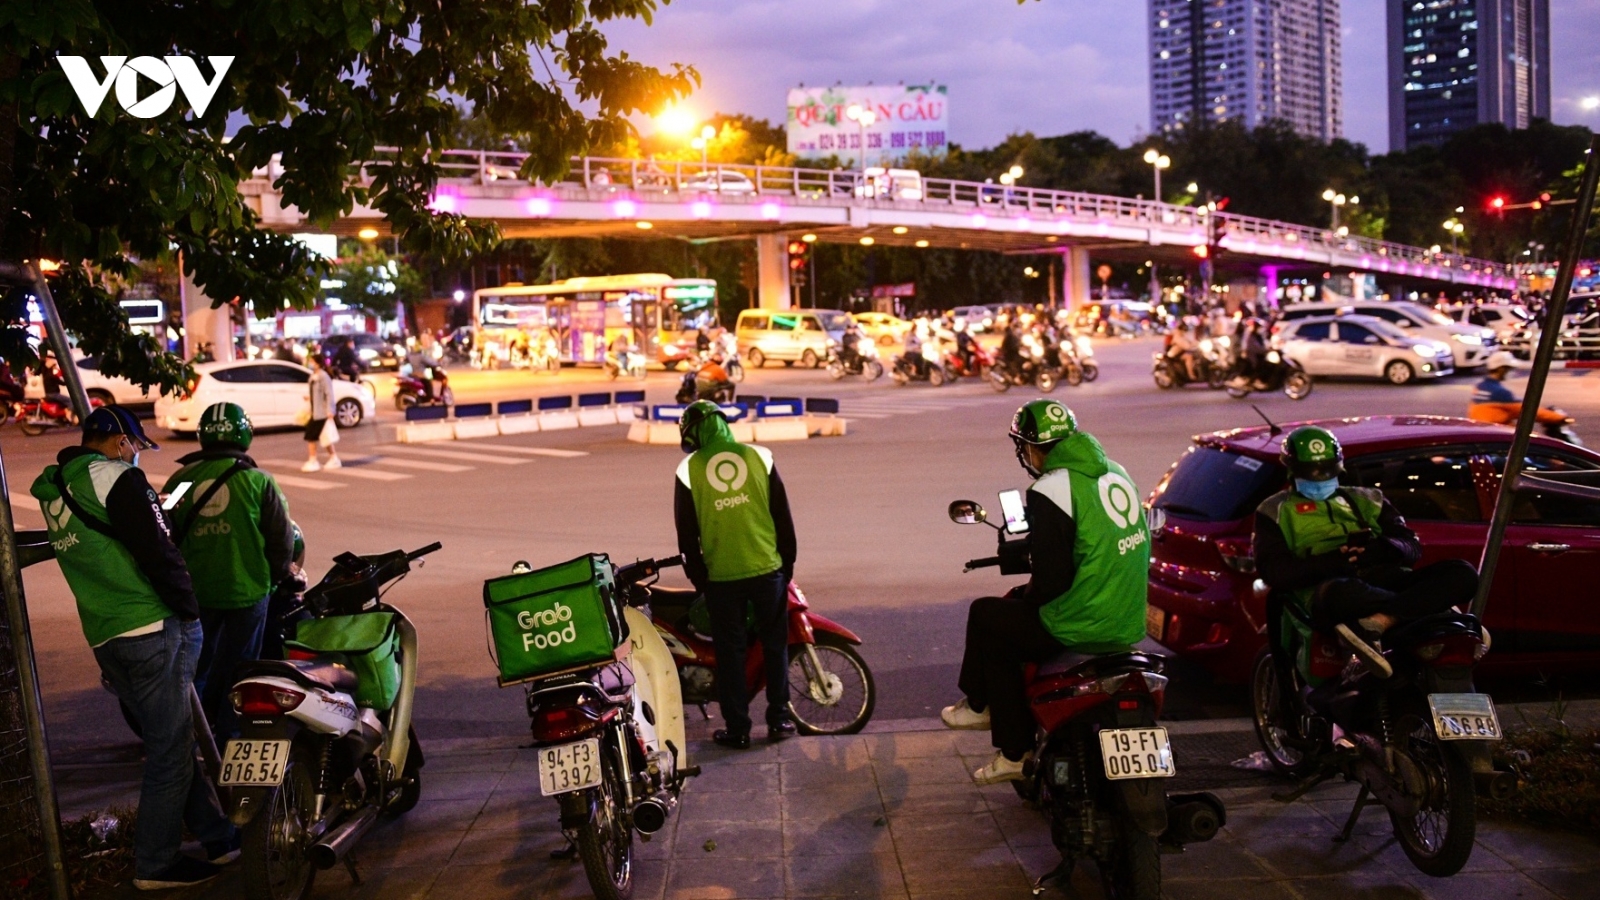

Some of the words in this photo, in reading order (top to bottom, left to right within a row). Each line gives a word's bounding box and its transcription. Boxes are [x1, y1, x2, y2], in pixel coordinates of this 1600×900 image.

[832, 98, 893, 122] TN
[205, 420, 234, 433] Grab
[1050, 423, 1069, 432] gojek
[714, 493, 750, 511] gojek
[193, 518, 232, 537] Grab
[1117, 528, 1146, 555] gojek
[517, 602, 572, 630] Grab
[522, 620, 576, 652] Food
[231, 742, 280, 761] 29-E1
[1111, 731, 1158, 753] 19-F1
[547, 743, 591, 769] 94-F3
[1109, 753, 1169, 775] 005.04
[222, 763, 279, 782] 816.54
[549, 764, 593, 790] 1392
